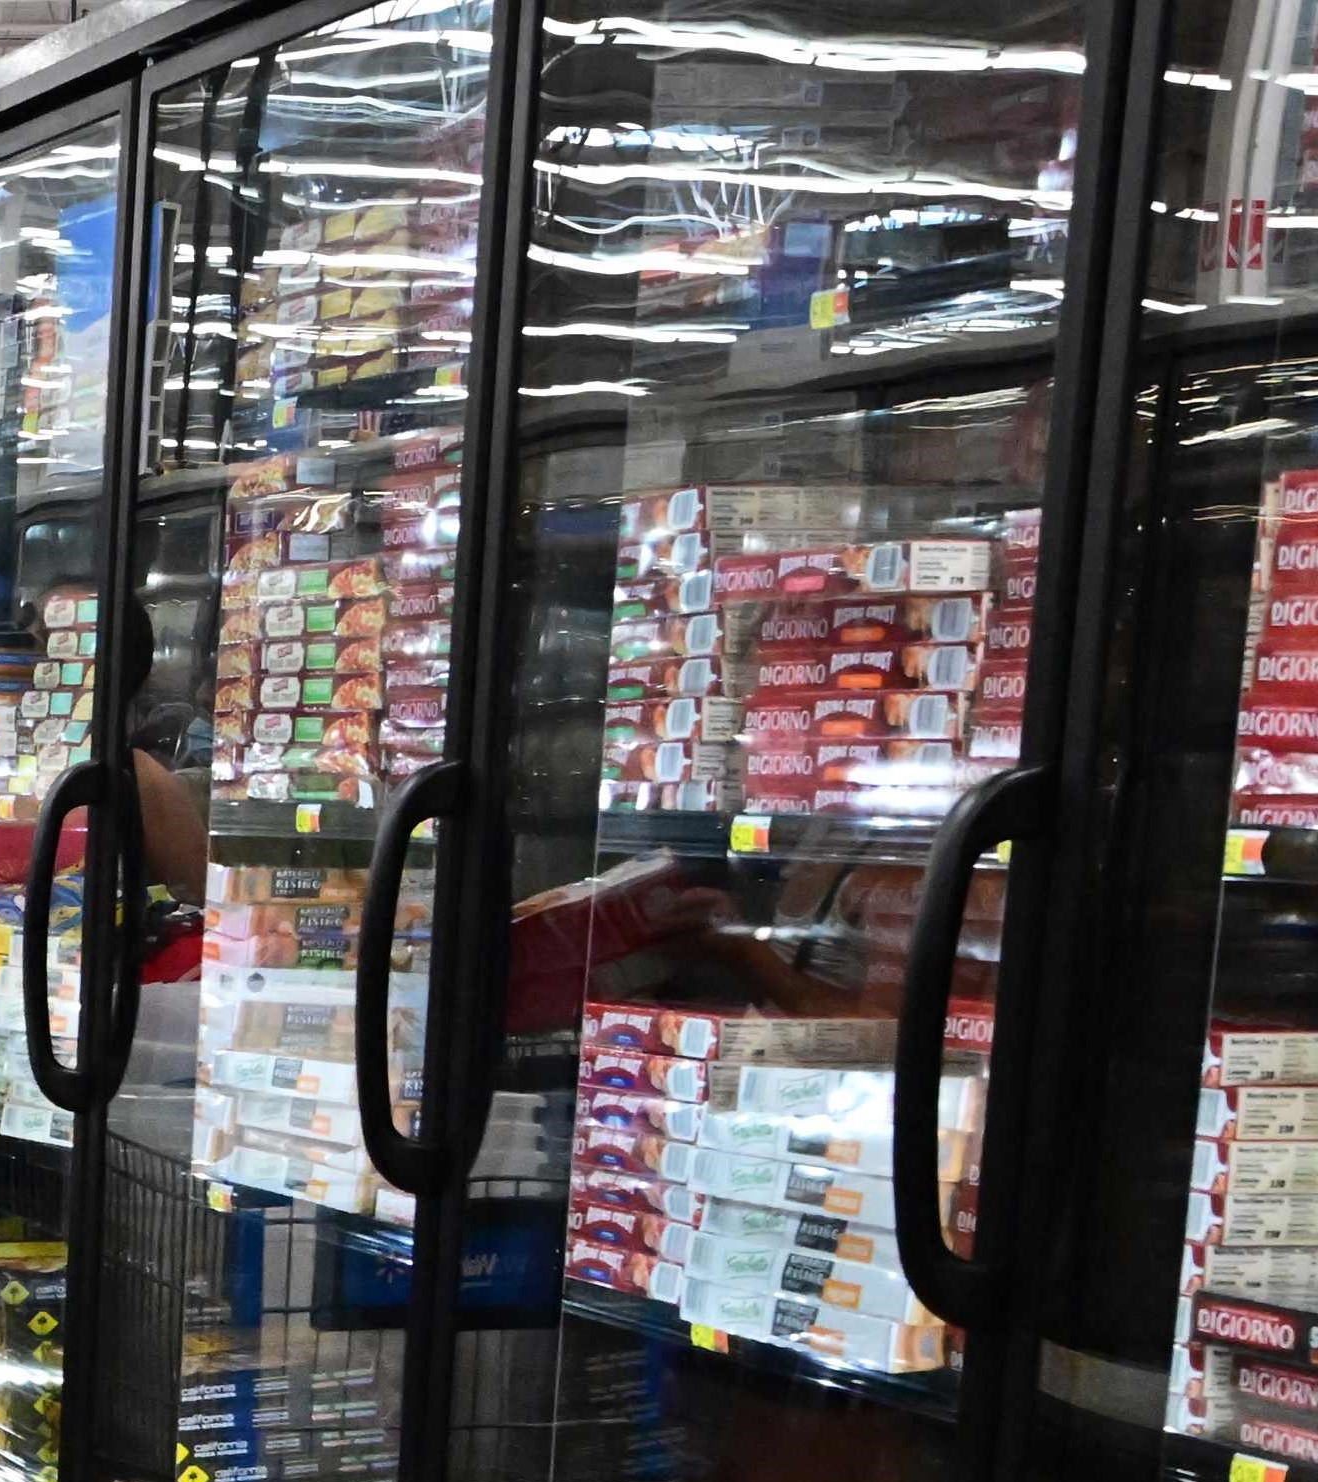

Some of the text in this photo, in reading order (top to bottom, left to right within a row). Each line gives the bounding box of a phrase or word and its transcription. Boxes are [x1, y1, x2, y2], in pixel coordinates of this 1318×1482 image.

[762, 618, 828, 641] DIGIORNO
[990, 626, 1031, 648] DIGIO
[759, 664, 826, 686] DIGIORNO
[1258, 656, 1318, 682] DIGIOR
[982, 676, 1025, 698] DIGIO
[745, 709, 810, 731] DIGIORNO
[1237, 710, 1318, 737] DIGIORN
[747, 755, 813, 776] DIGIORNO
[1240, 809, 1318, 826] DIGIORN
[1197, 1308, 1295, 1349] DIGIORNO
[1239, 1368, 1318, 1407] DIGIORN
[1239, 1423, 1318, 1462] DIGIORN
